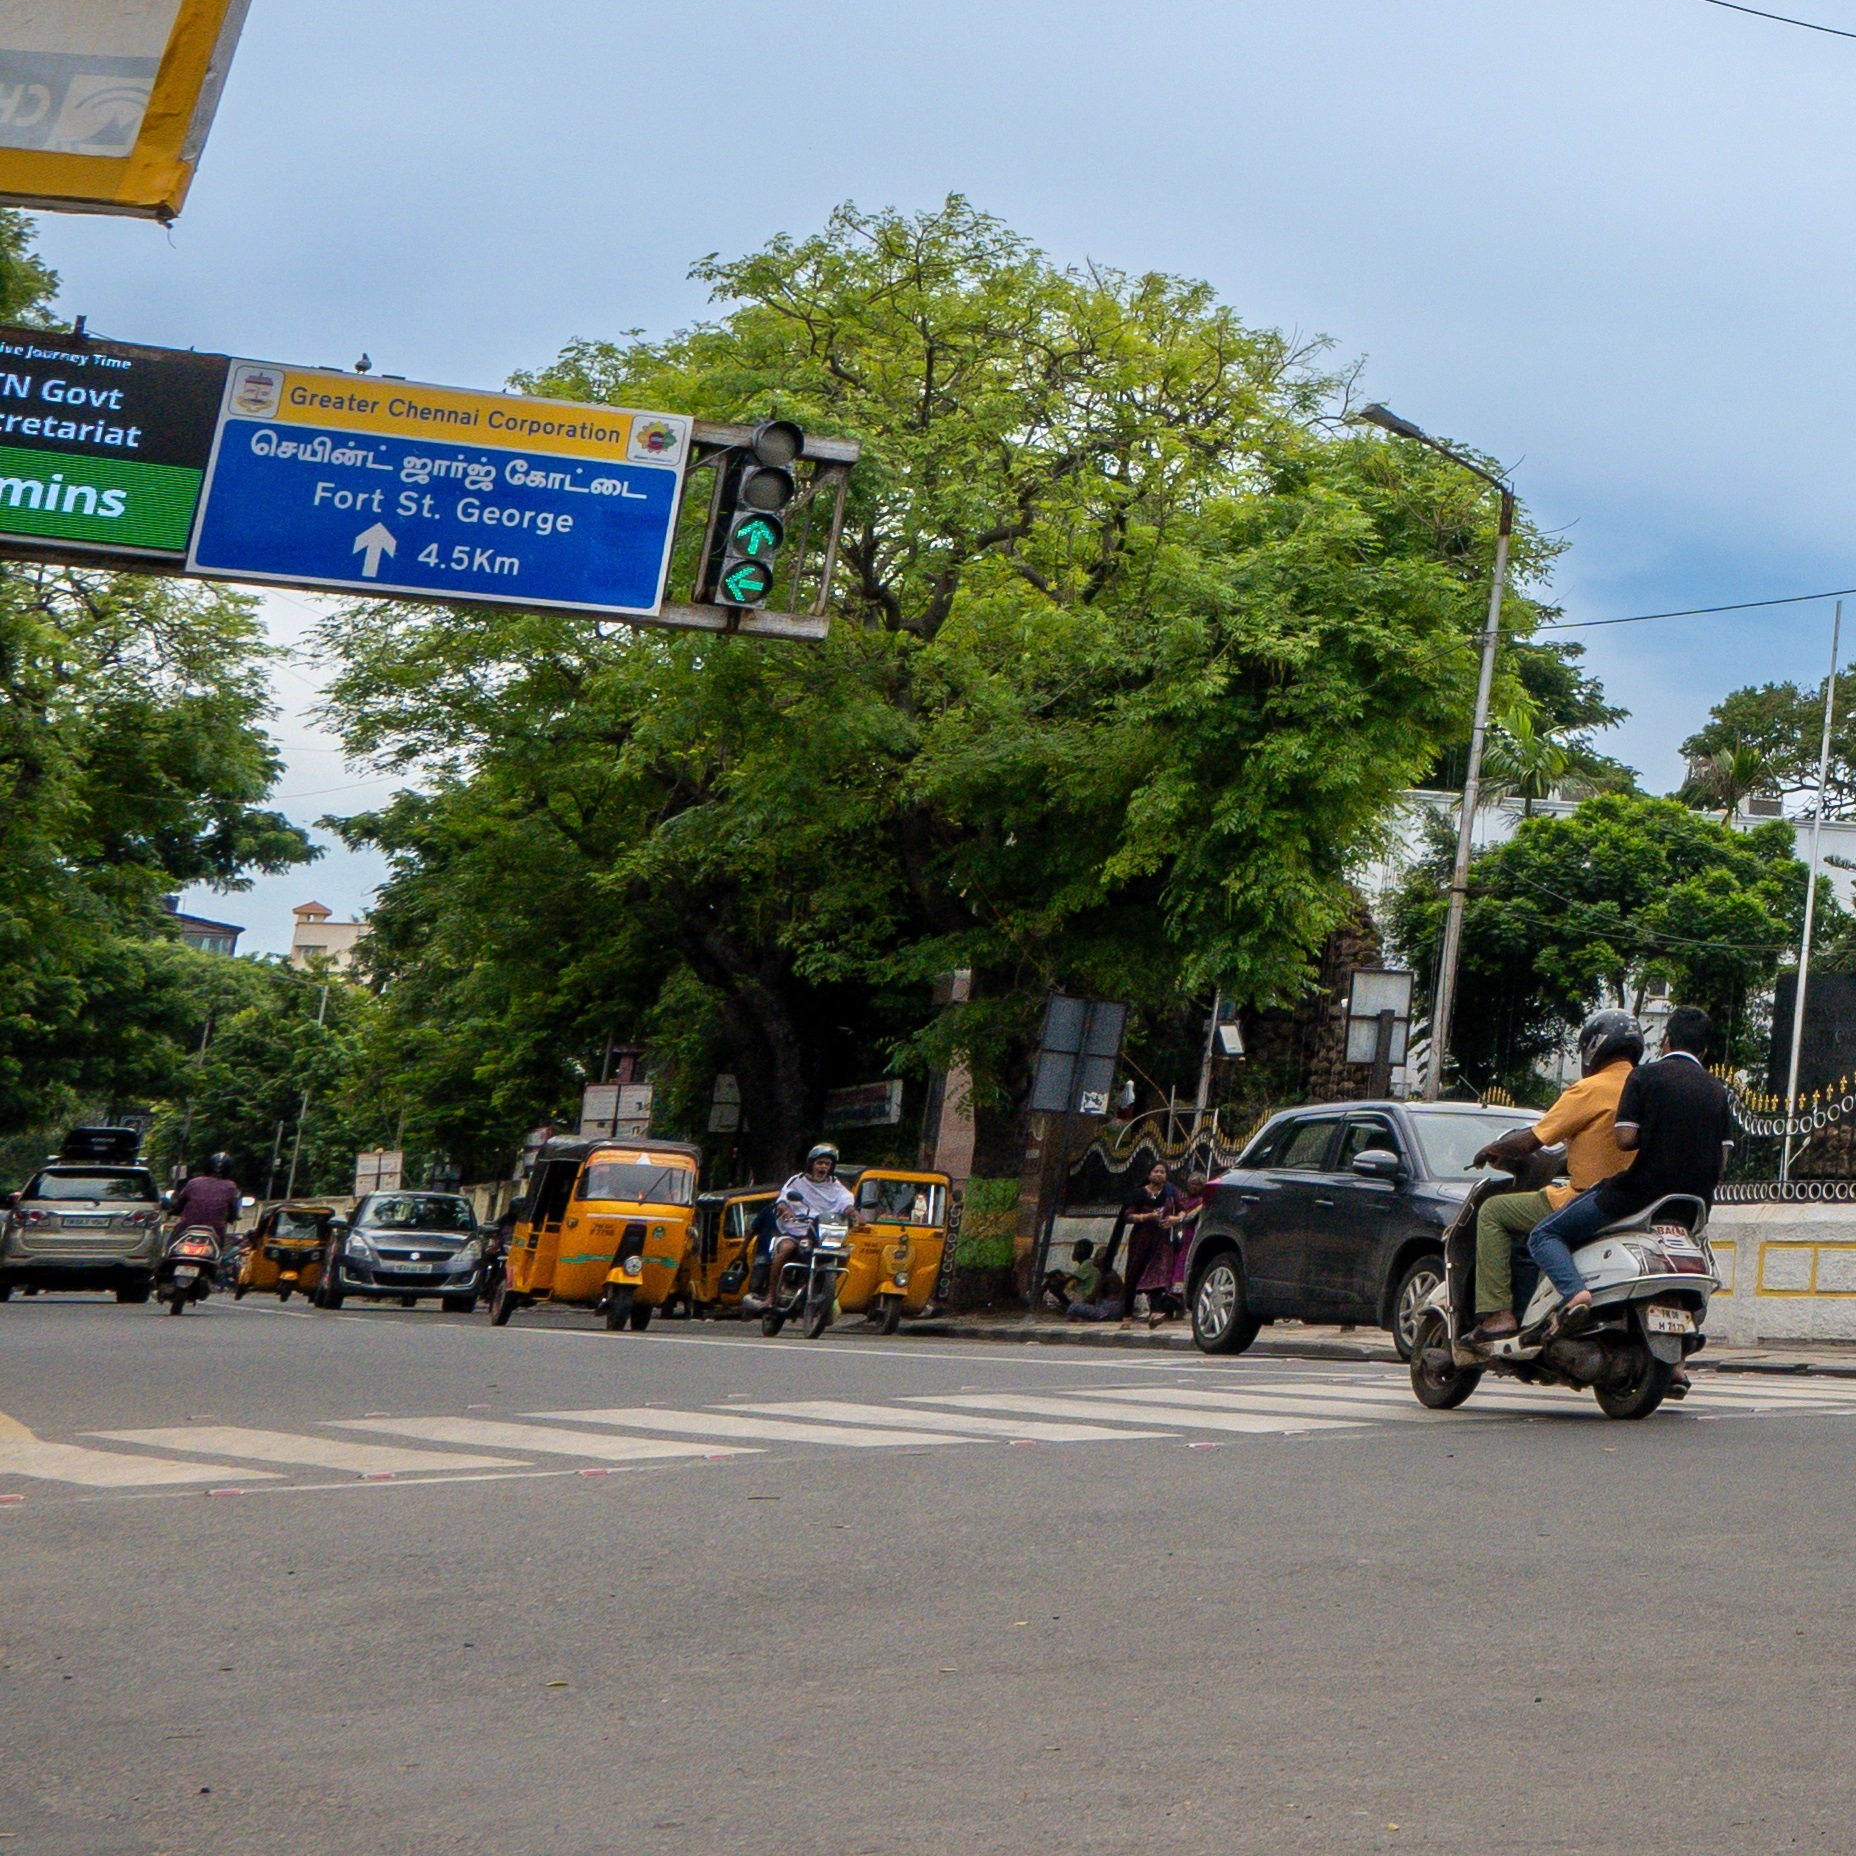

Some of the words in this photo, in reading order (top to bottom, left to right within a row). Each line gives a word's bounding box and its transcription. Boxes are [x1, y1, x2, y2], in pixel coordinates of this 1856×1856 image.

[25, 345, 89, 367] Journey
[93, 353, 132, 370] Time
[41, 379, 124, 410] Govt
[0, 414, 142, 449] retariat
[289, 386, 379, 414] Greater
[388, 398, 479, 426] Chennai
[488, 409, 620, 444] Corporation
[250, 429, 394, 471] செயின்ட்
[400, 454, 497, 492] ஜார்ஜ்
[504, 458, 648, 500] கோட்டை
[313, 481, 385, 513] Fort
[396, 490, 440, 520] St.
[456, 497, 574, 536] George
[417, 542, 521, 576] 4.5Km
